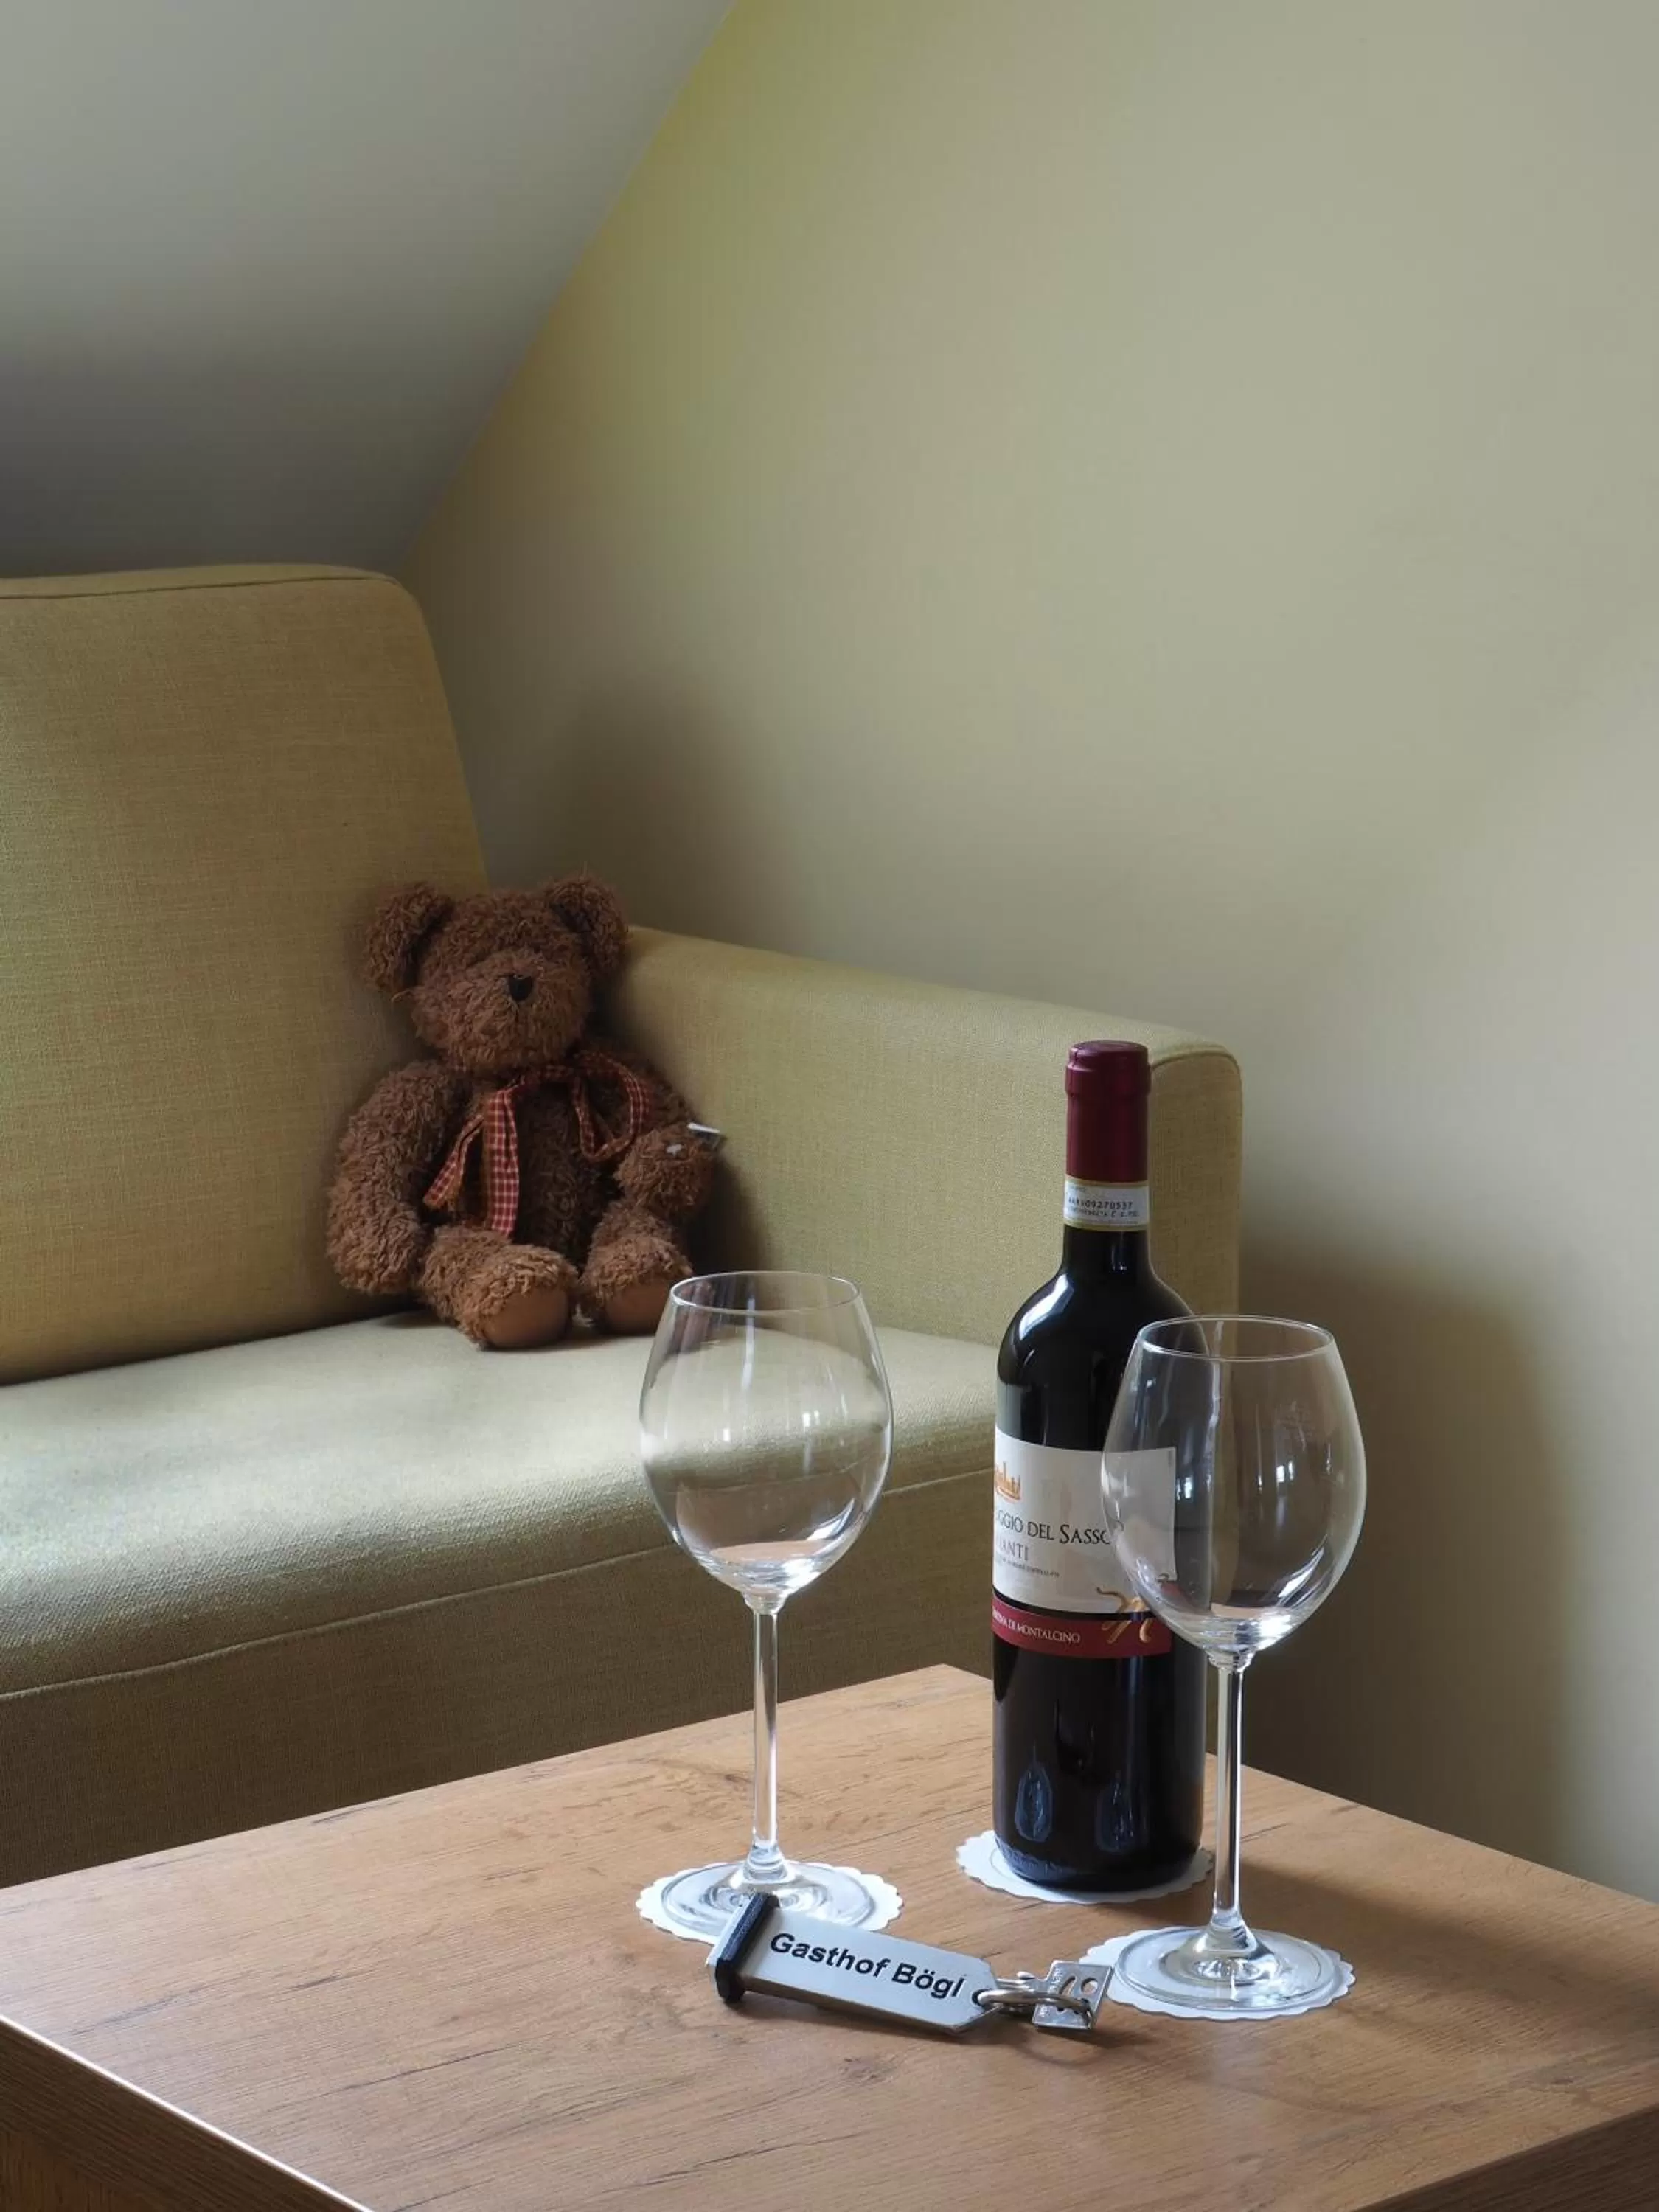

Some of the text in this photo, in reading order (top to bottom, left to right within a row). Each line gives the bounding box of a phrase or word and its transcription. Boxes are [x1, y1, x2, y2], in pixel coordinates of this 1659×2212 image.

[1027, 1521, 1054, 1540] DEL
[771, 1933, 964, 1999] Gasthof Bögl
